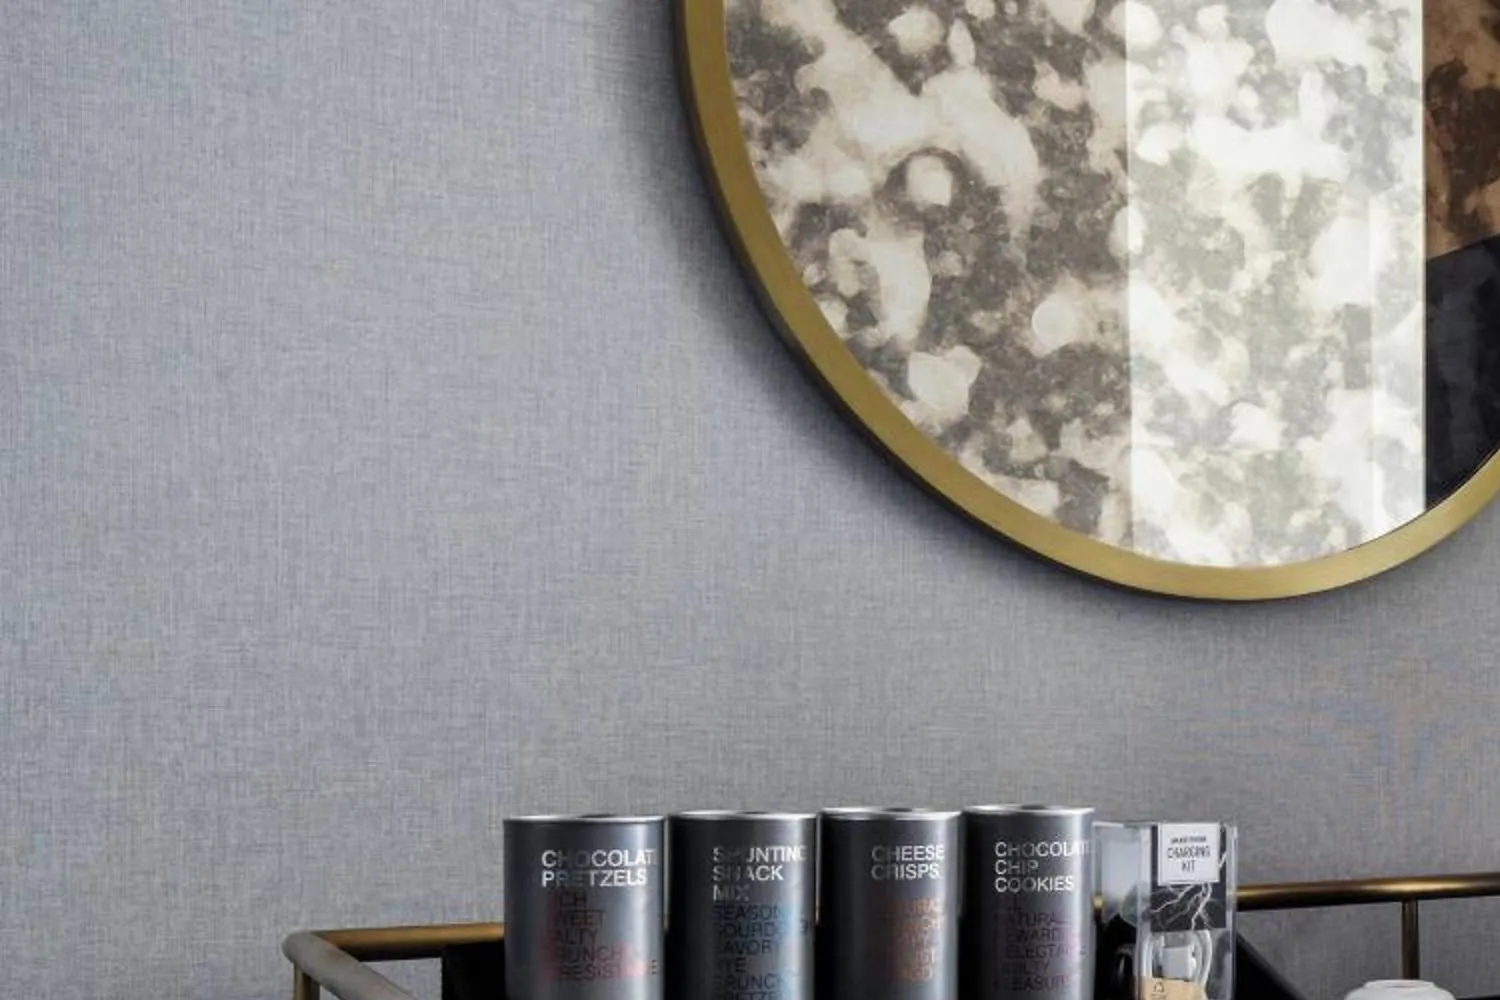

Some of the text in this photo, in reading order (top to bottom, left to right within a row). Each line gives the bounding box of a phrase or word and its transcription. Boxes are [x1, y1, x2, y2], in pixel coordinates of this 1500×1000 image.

[541, 848, 658, 868] CHOCOLAT
[870, 844, 945, 862] CHEESE
[712, 864, 784, 882] SNACK
[870, 863, 942, 881] CRISPS
[993, 859, 1039, 876] CHIP
[1181, 860, 1196, 873] KIT
[541, 868, 647, 888] PRETZELS
[993, 875, 1076, 894] COOKIES
[712, 884, 750, 901] MIX
[712, 904, 788, 920] SEASON
[548, 928, 599, 944] ALTY
